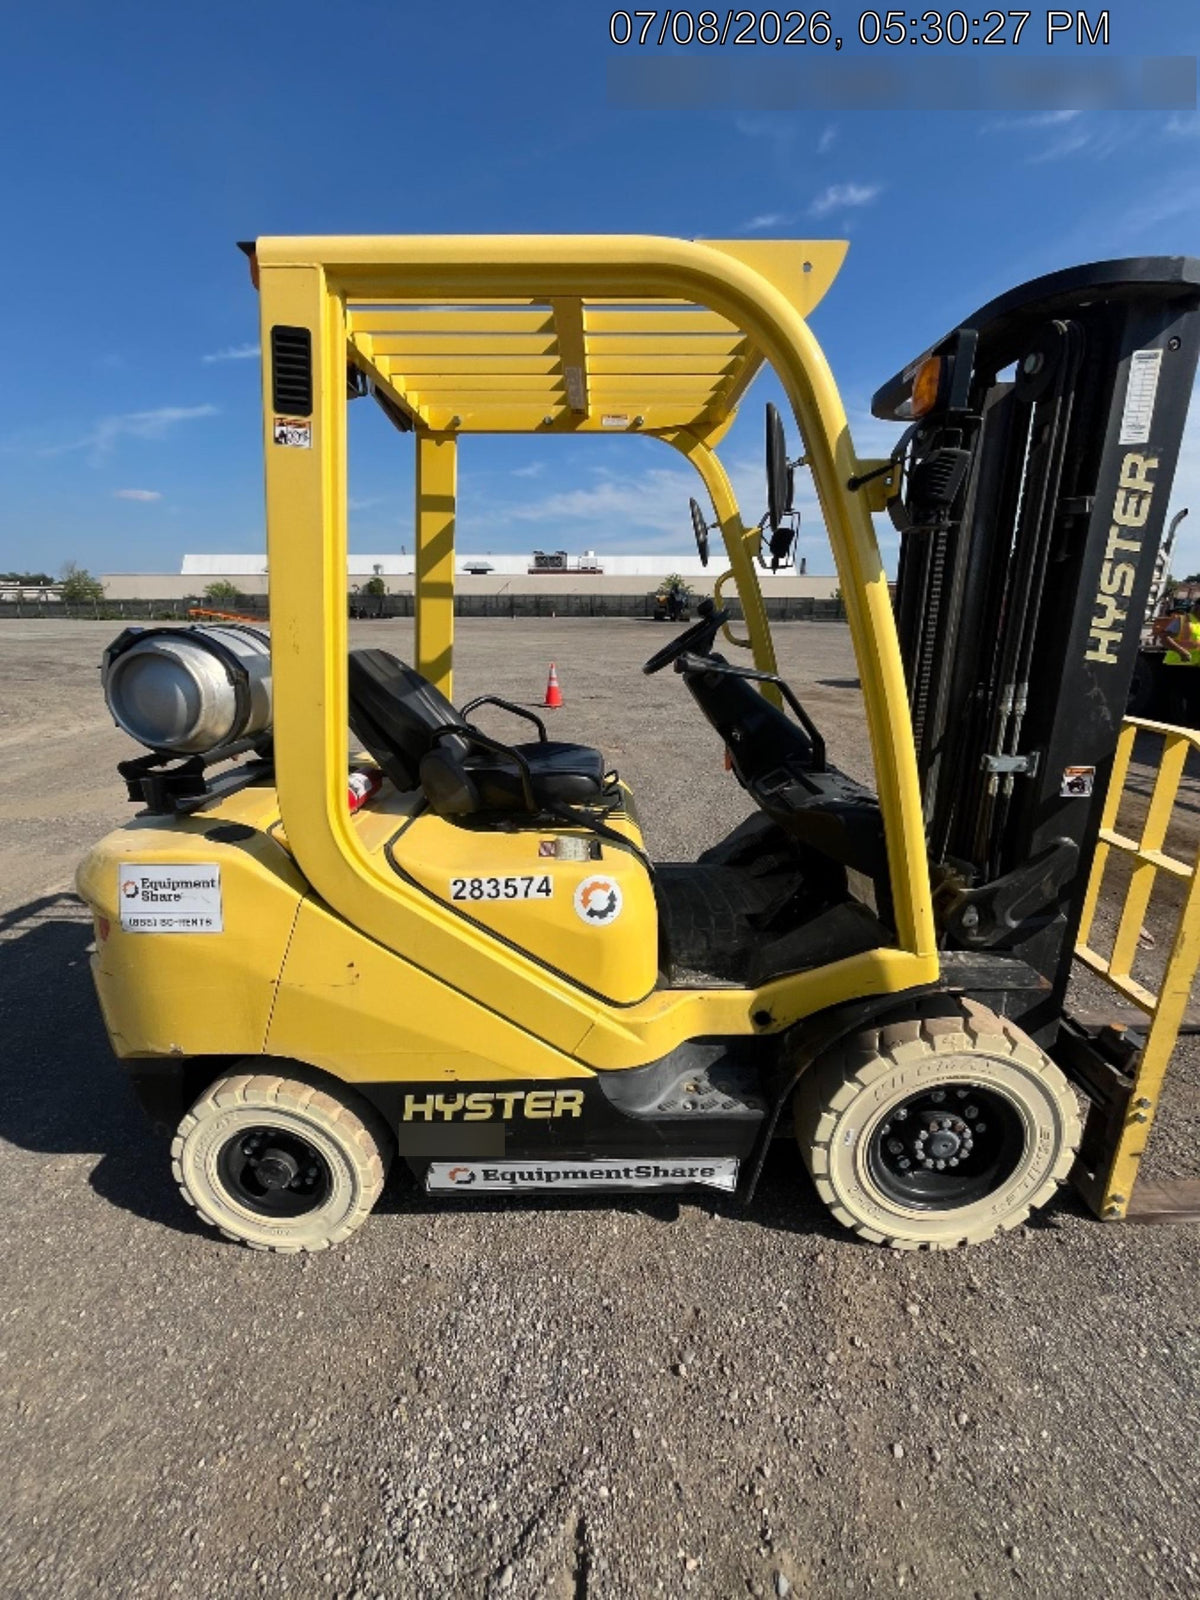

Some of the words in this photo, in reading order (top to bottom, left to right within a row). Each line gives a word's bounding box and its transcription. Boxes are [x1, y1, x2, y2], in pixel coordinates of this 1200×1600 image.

[1085, 451, 1160, 664] HYSTER
[141, 877, 216, 891] Equipment
[452, 875, 552, 901] 283574
[141, 890, 182, 902] Share
[402, 1088, 586, 1122] HYSTER
[482, 1165, 717, 1184] EquipmentShare
